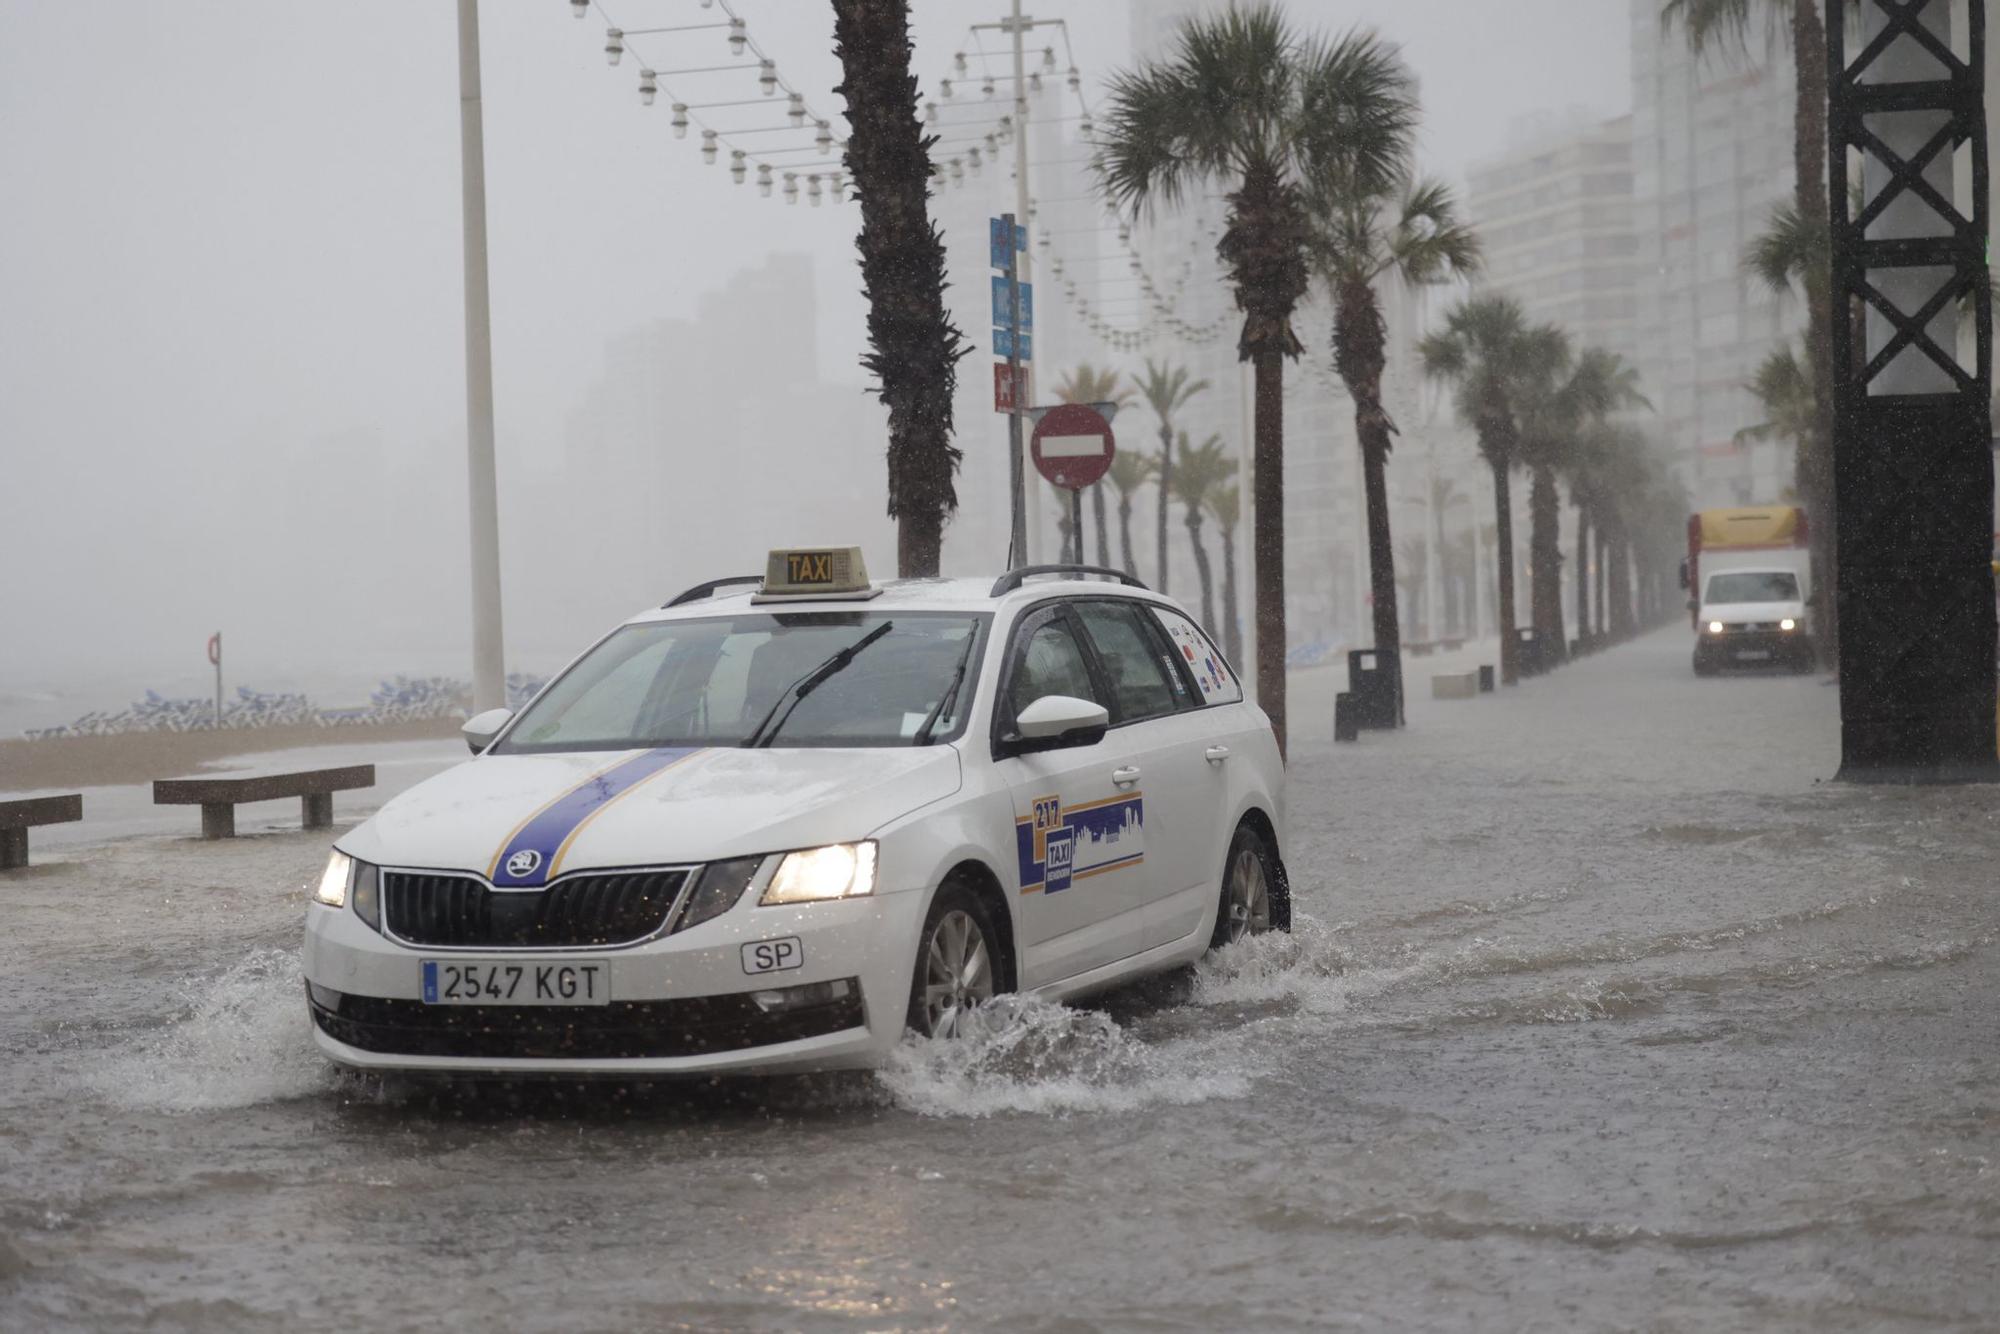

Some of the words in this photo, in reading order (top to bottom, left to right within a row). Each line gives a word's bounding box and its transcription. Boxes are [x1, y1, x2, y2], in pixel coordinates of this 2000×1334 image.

[788, 554, 832, 581] TAXI
[1035, 799, 1059, 829] 217
[1049, 842, 1070, 865] TAXI
[755, 942, 793, 969] SP
[444, 966, 523, 999] 2547
[536, 966, 599, 999] KGT
